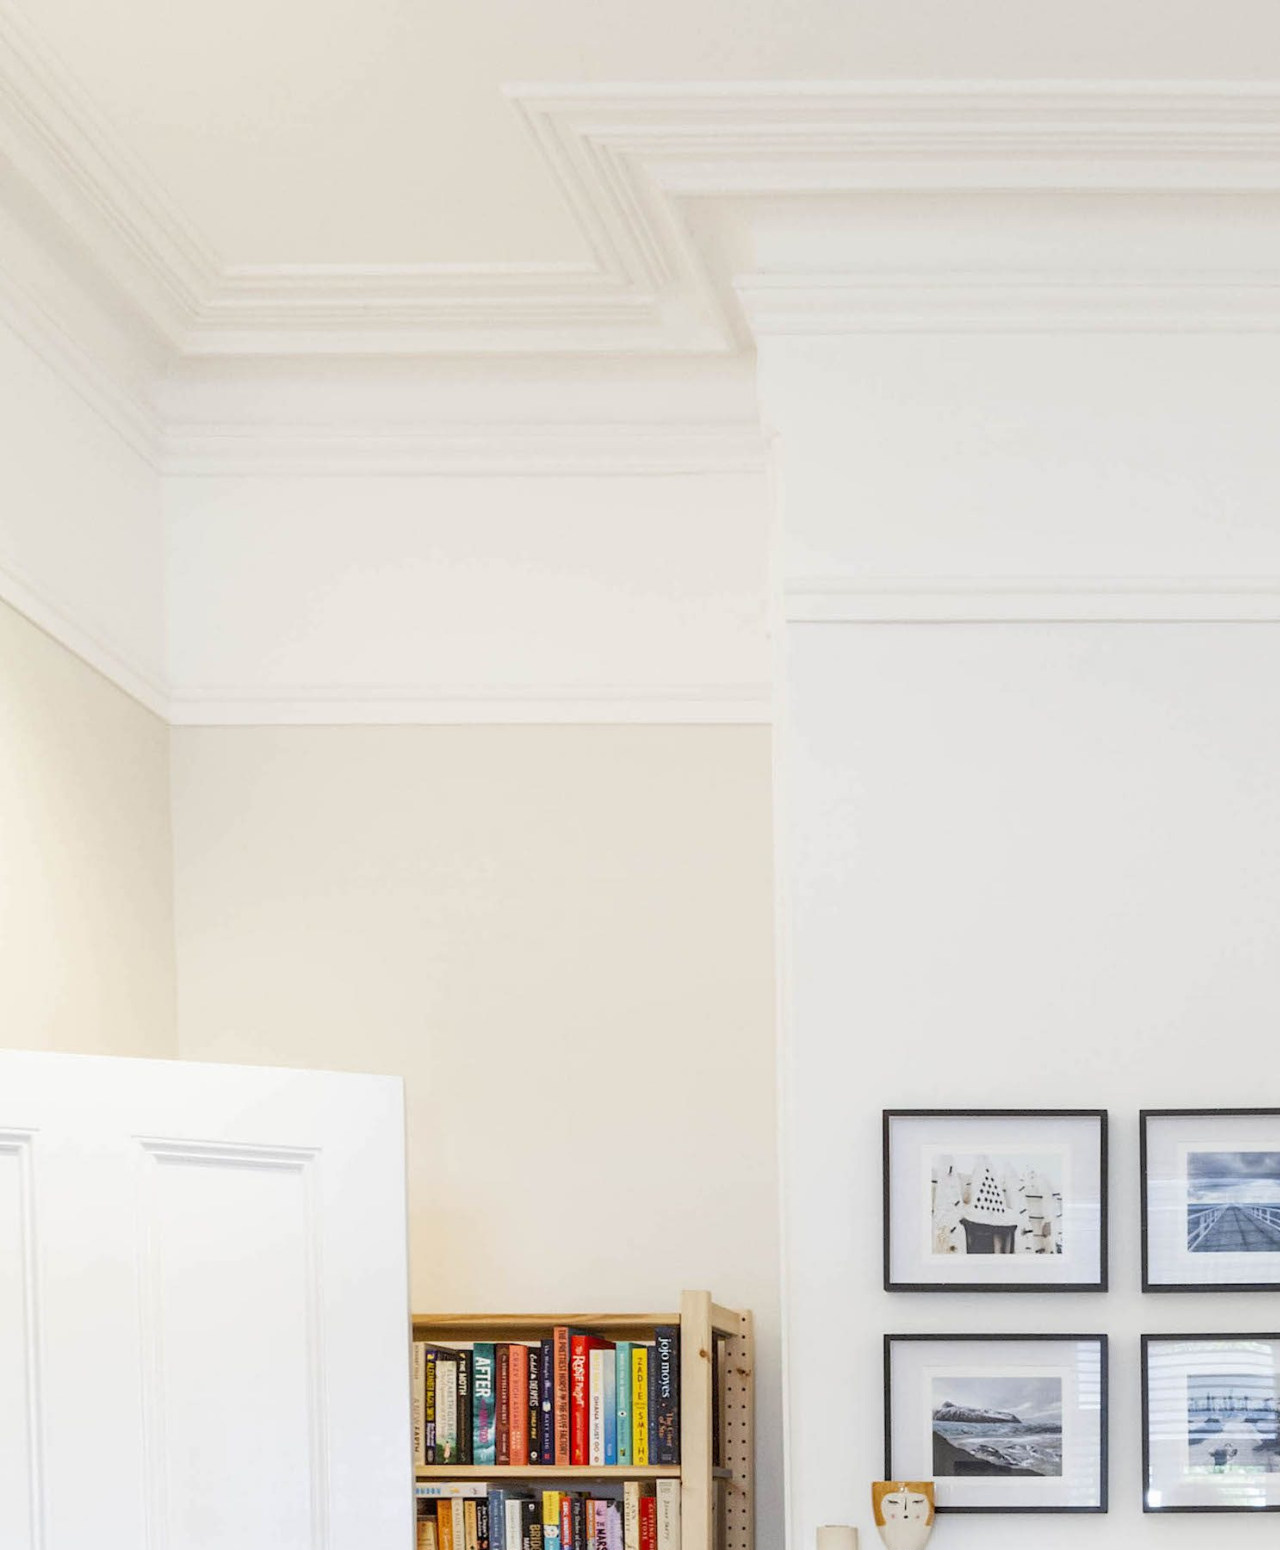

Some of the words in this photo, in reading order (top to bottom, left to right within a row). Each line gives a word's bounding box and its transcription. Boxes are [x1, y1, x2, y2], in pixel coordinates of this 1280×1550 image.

[658, 1337, 671, 1360] jojo
[458, 1372, 467, 1396] MOTH
[474, 1357, 491, 1397] AFTER
[658, 1362, 671, 1398] moyes
[559, 1430, 568, 1455] FACTORY
